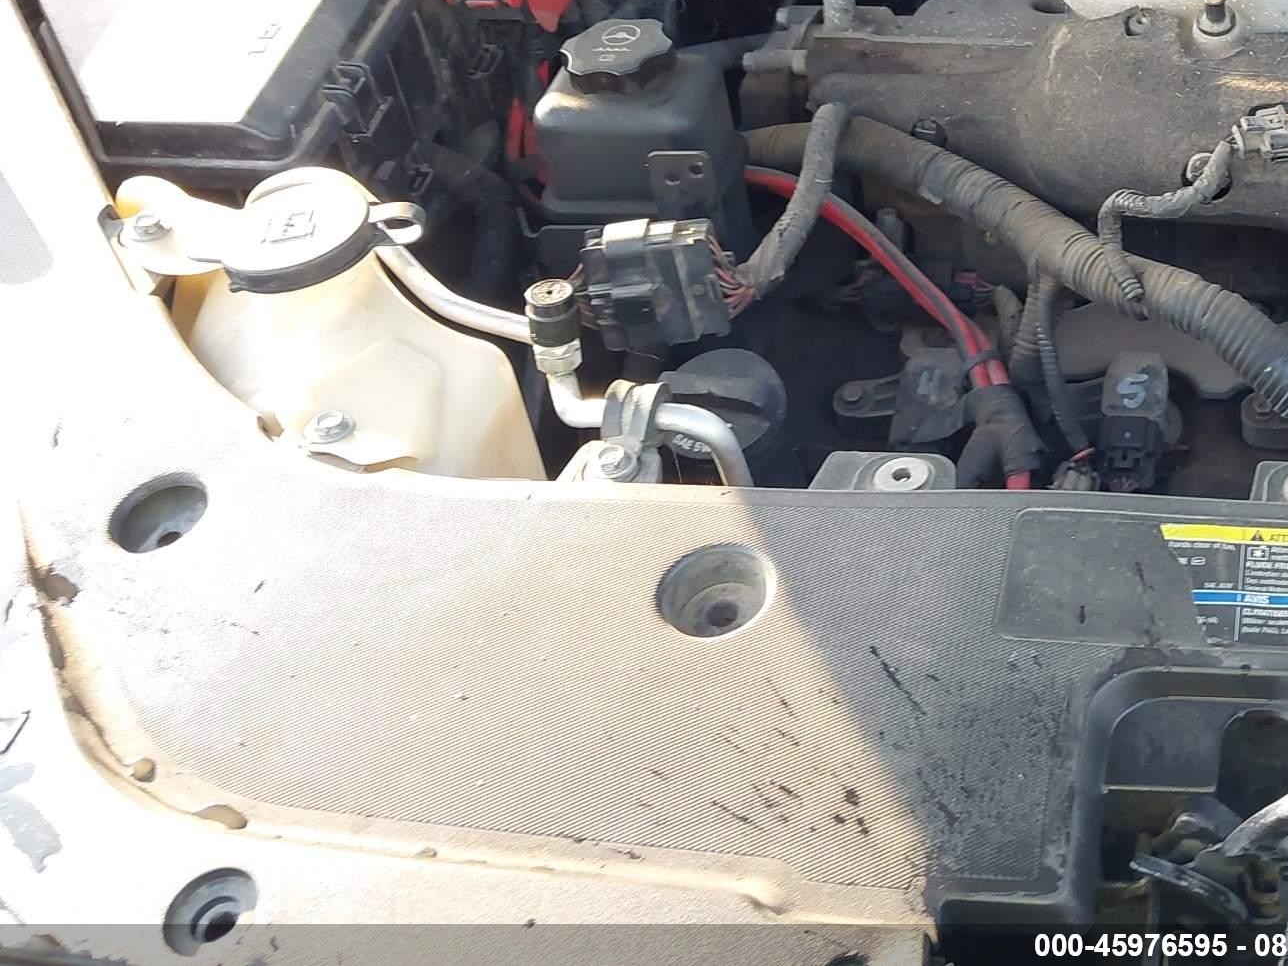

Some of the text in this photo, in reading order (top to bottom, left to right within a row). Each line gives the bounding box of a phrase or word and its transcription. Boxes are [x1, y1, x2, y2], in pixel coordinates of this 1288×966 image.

[1116, 372, 1149, 409] 5
[672, 433, 694, 451] SAE
[1243, 594, 1271, 604] AVIS
